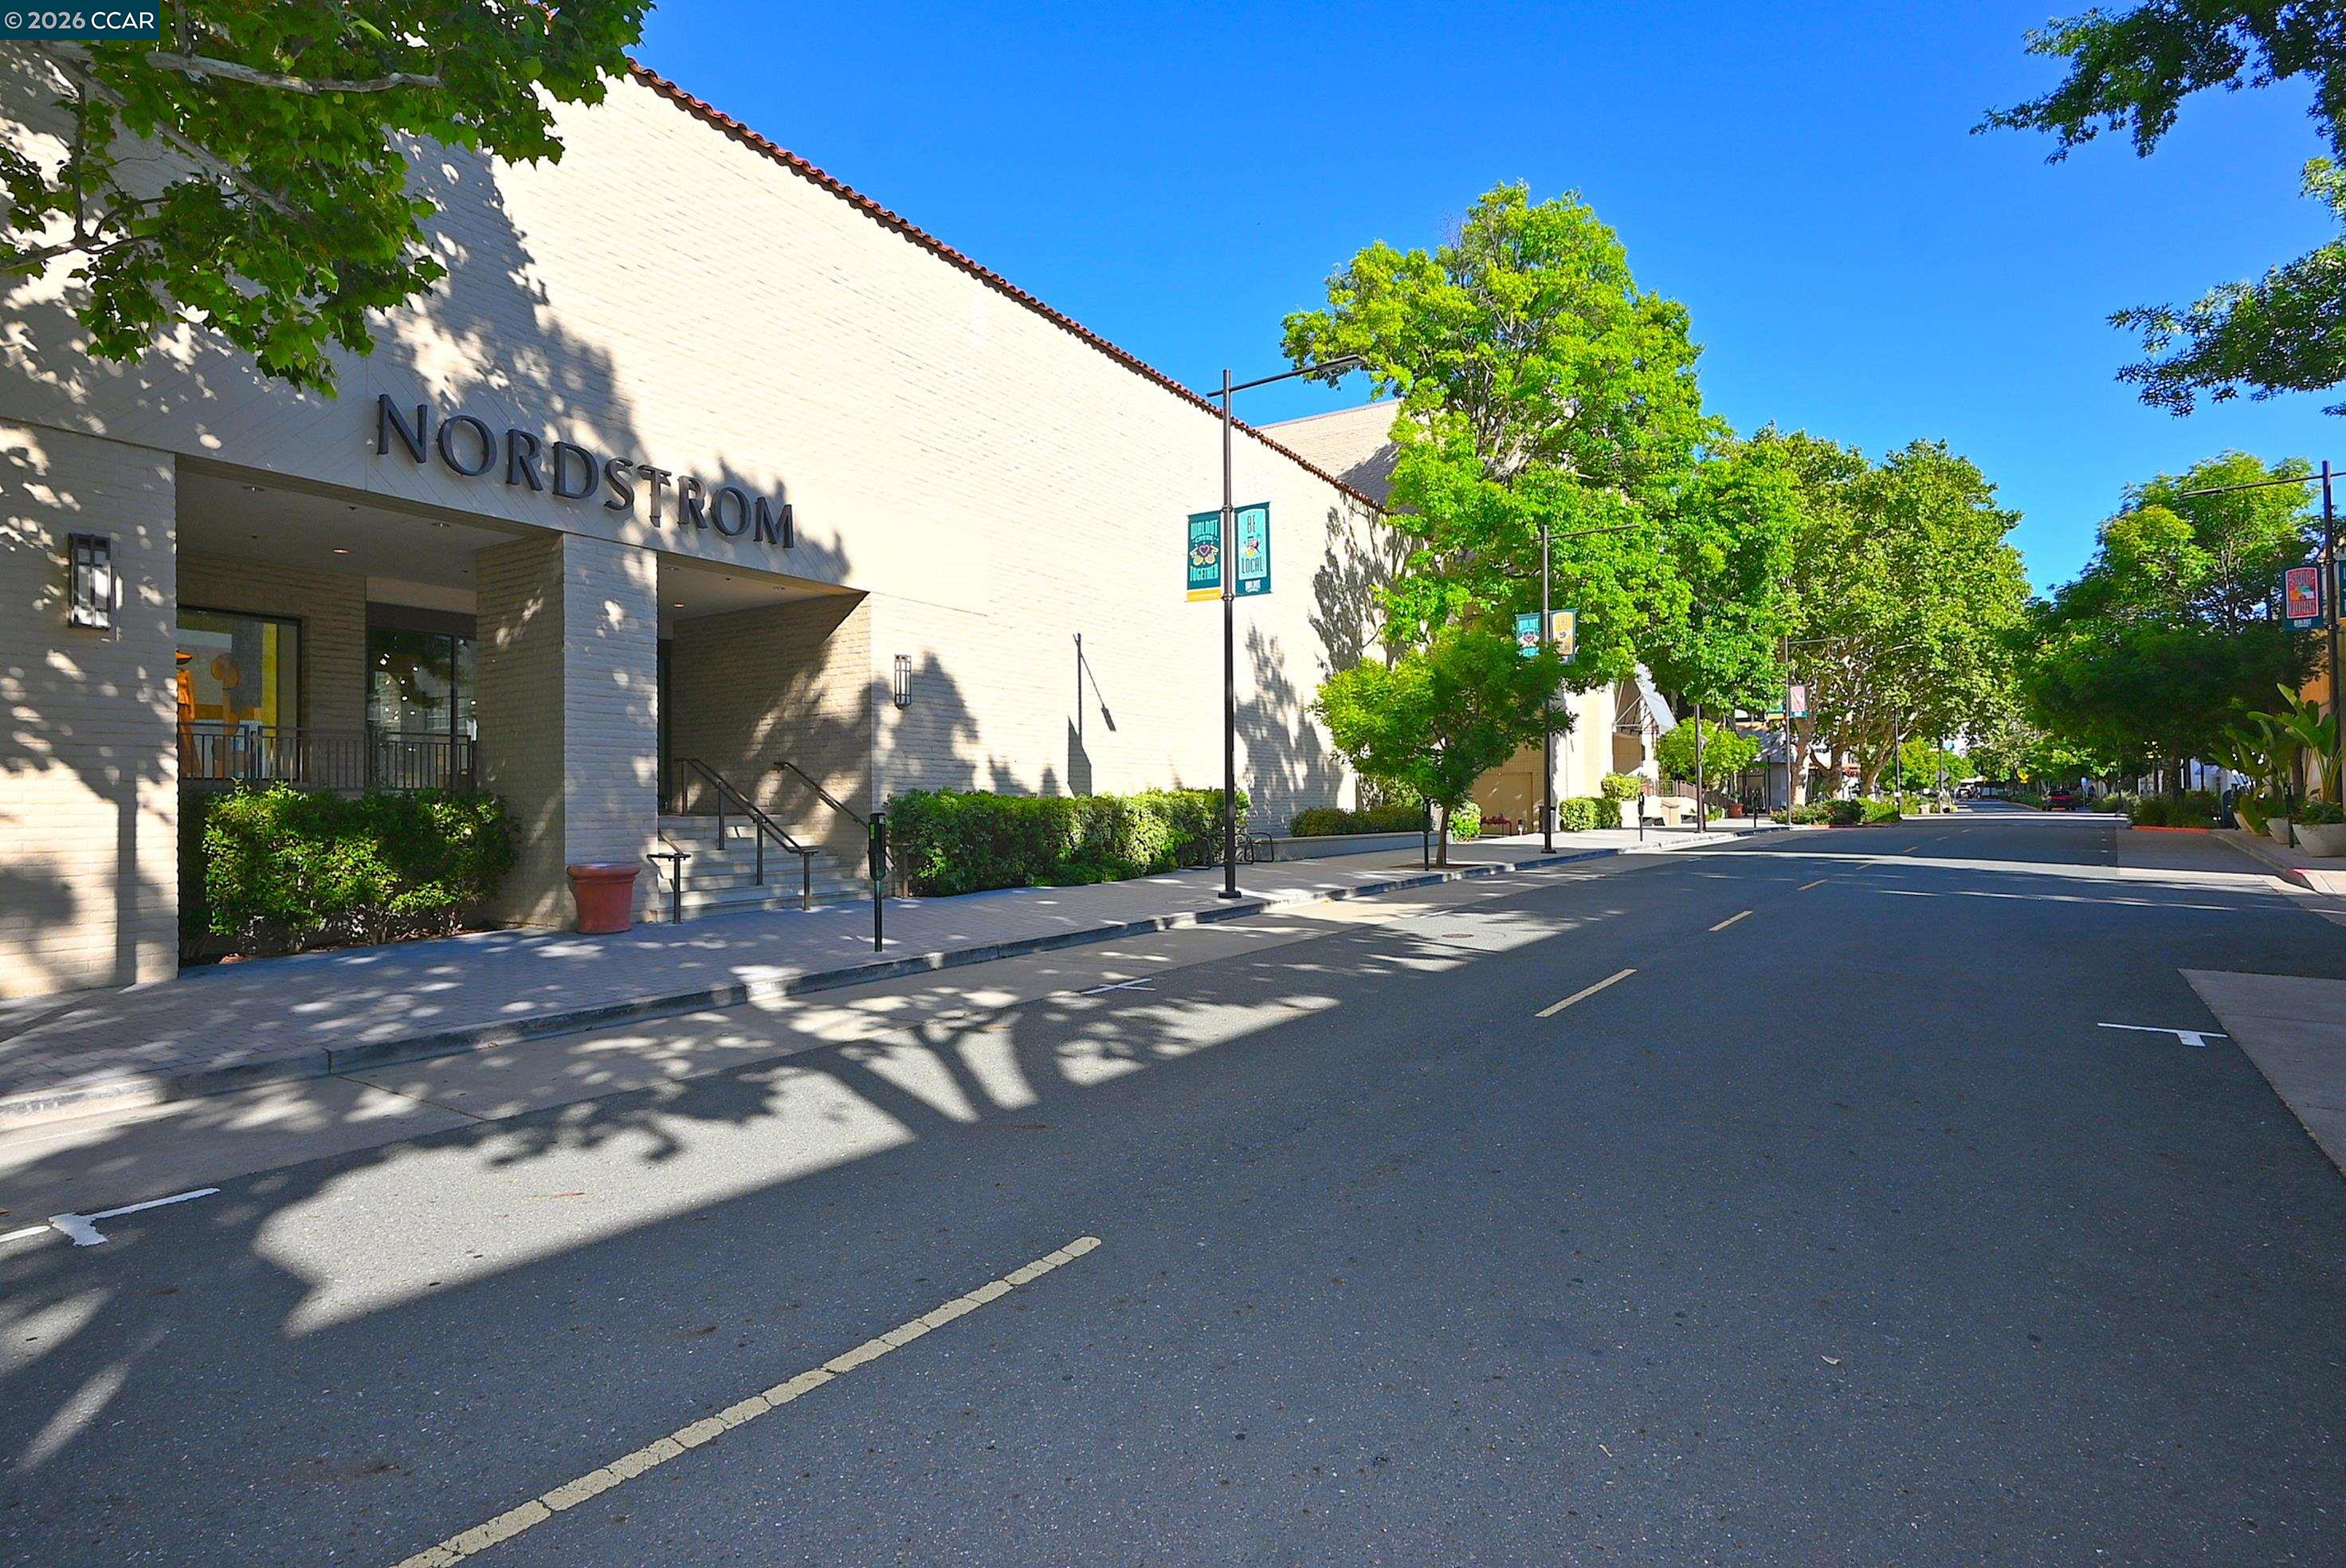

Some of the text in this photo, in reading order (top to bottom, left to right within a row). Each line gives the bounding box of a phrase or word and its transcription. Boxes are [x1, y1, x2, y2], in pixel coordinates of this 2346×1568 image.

[376, 394, 795, 549] NORDSTROM
[1191, 519, 1218, 540] WALNUT
[1247, 515, 1257, 534] BE
[1190, 563, 1219, 582] TOGETHER
[1242, 556, 1264, 574] LOCAL
